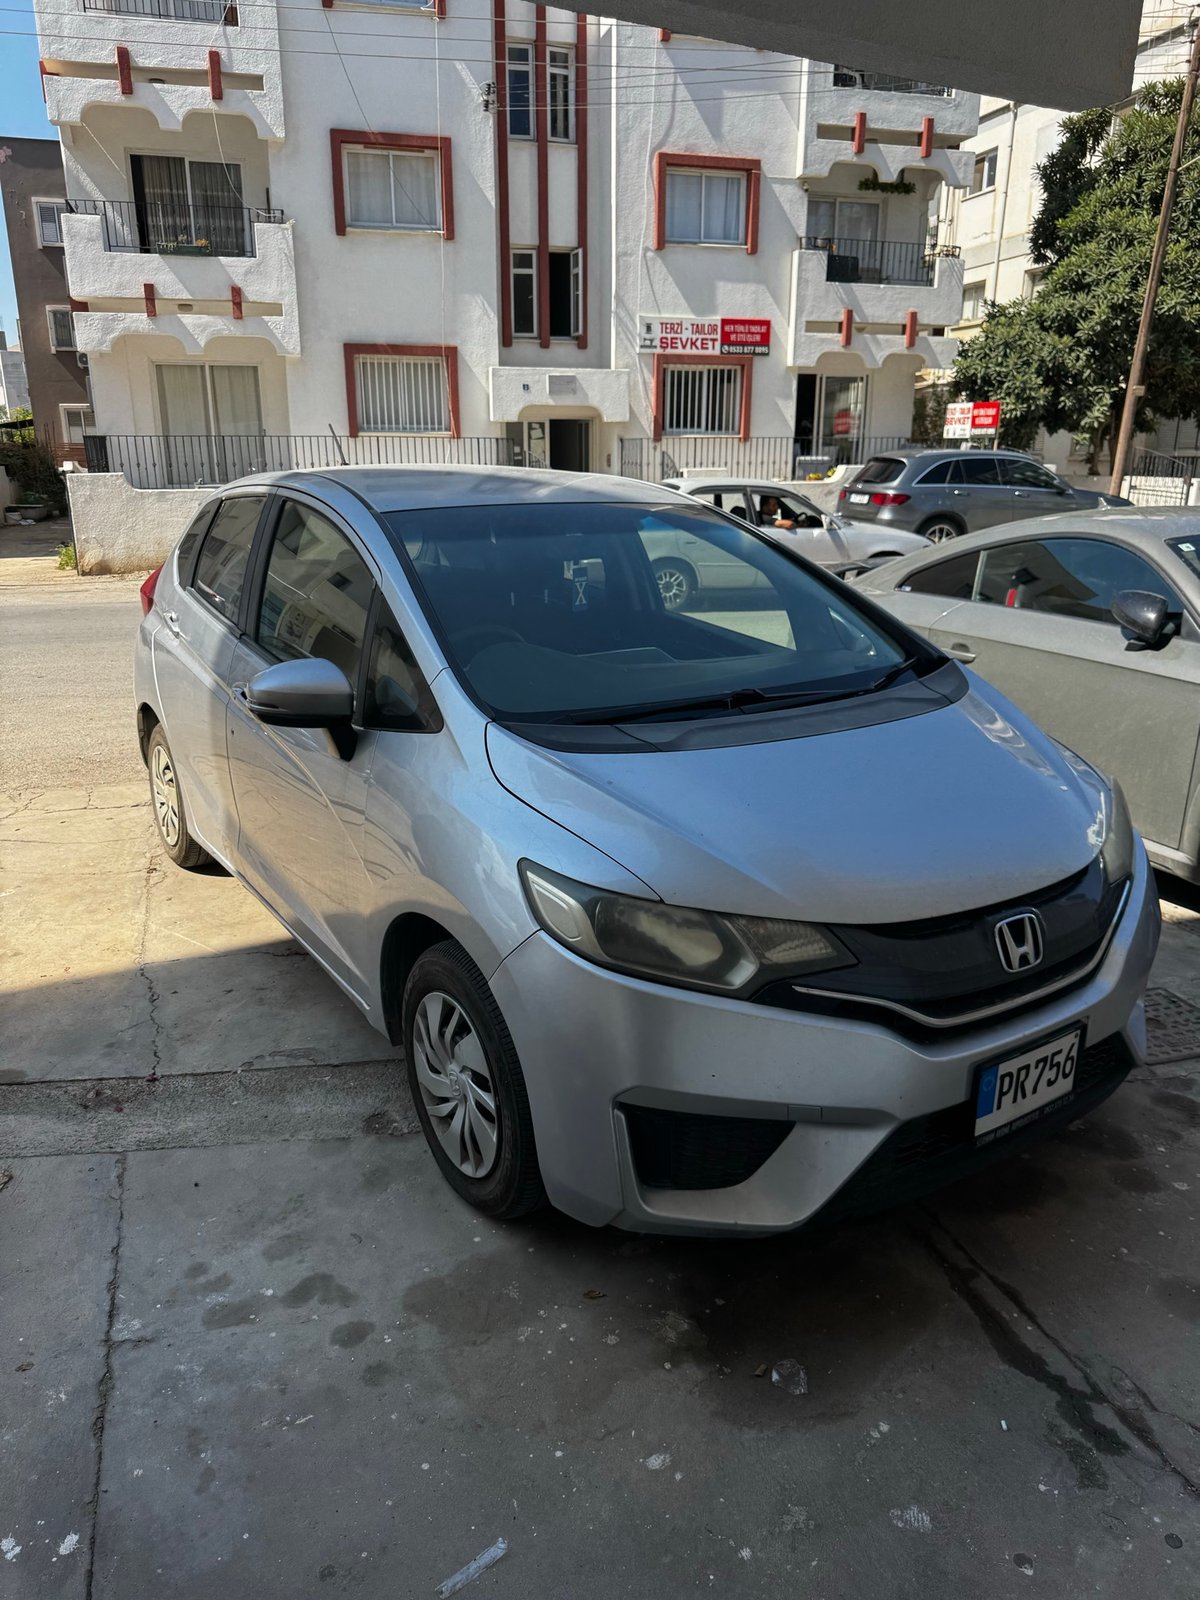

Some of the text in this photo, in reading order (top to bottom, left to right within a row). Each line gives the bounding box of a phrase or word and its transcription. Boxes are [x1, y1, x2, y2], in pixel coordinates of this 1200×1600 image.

[659, 320, 683, 335] TERZİ
[690, 323, 718, 336] TAILOR
[659, 336, 719, 352] ŞEVKET
